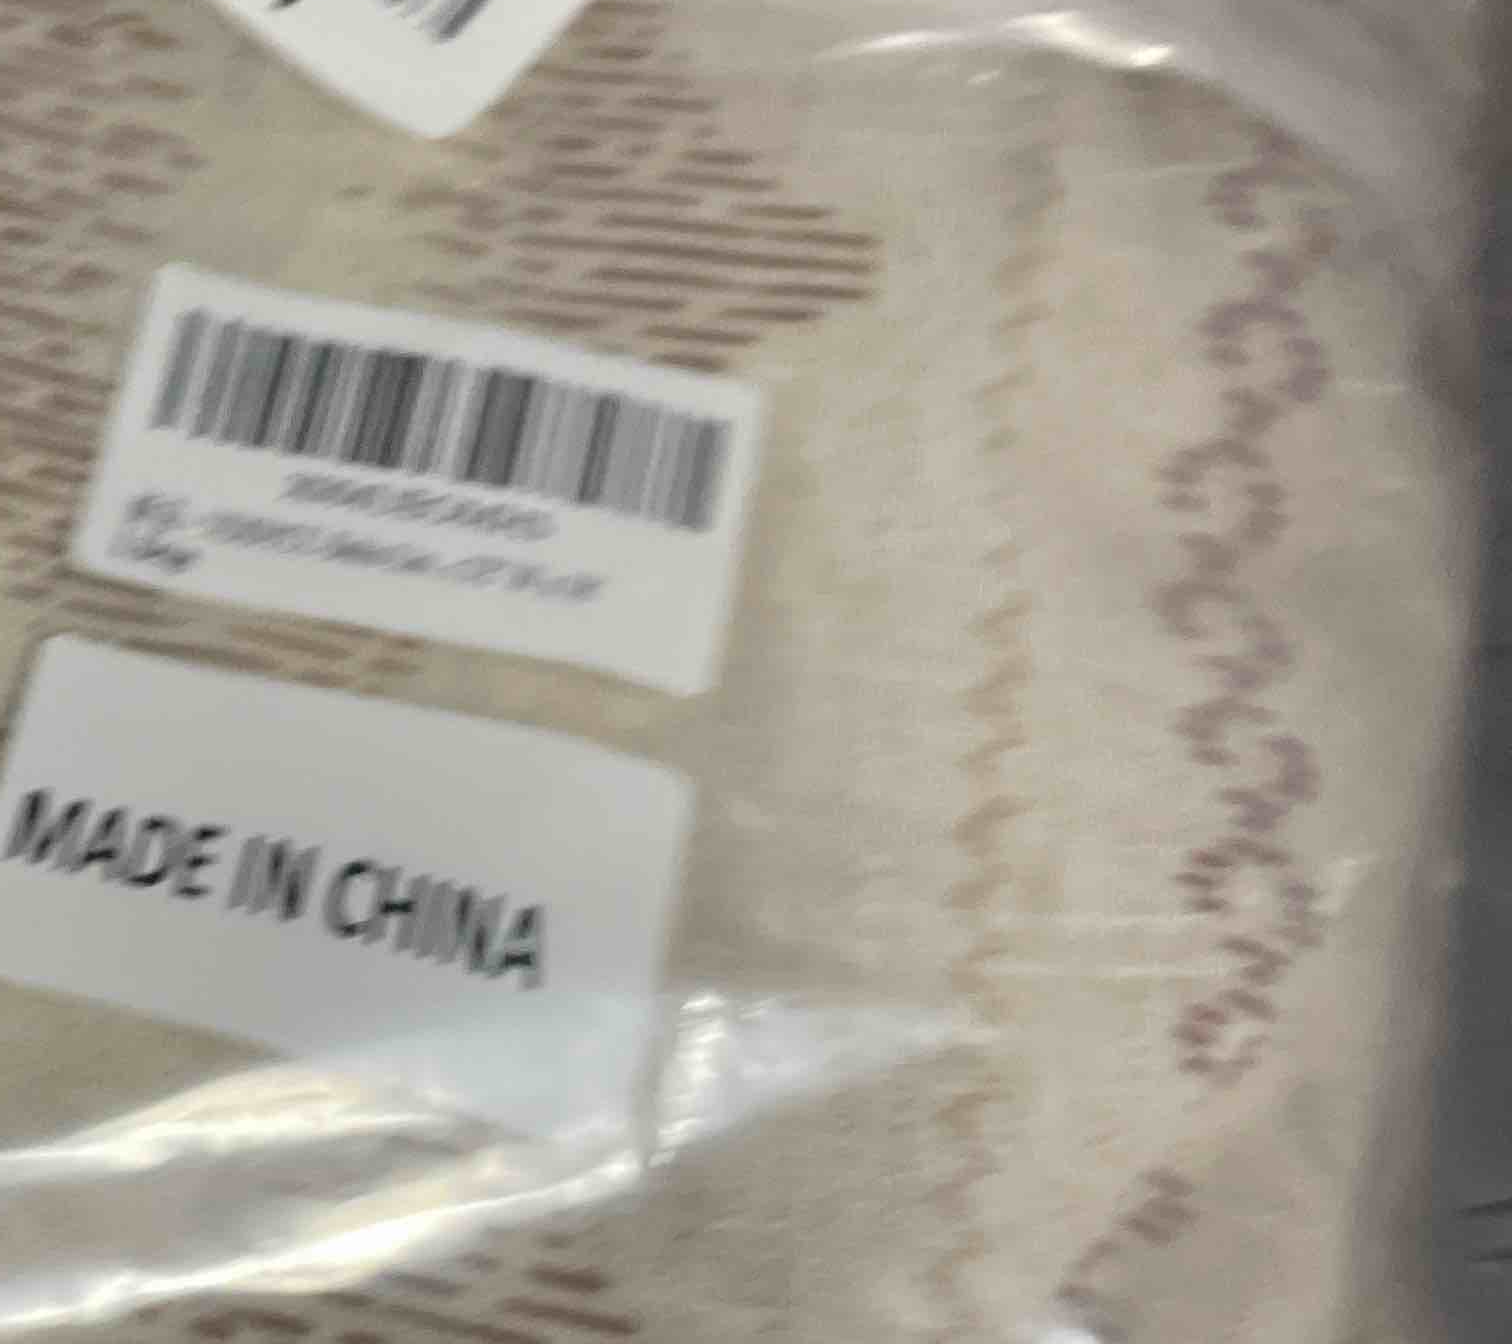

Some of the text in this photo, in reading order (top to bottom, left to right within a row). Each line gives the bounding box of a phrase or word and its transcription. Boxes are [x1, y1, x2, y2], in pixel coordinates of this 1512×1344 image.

[2, 788, 544, 992] MADE IN CHINA
